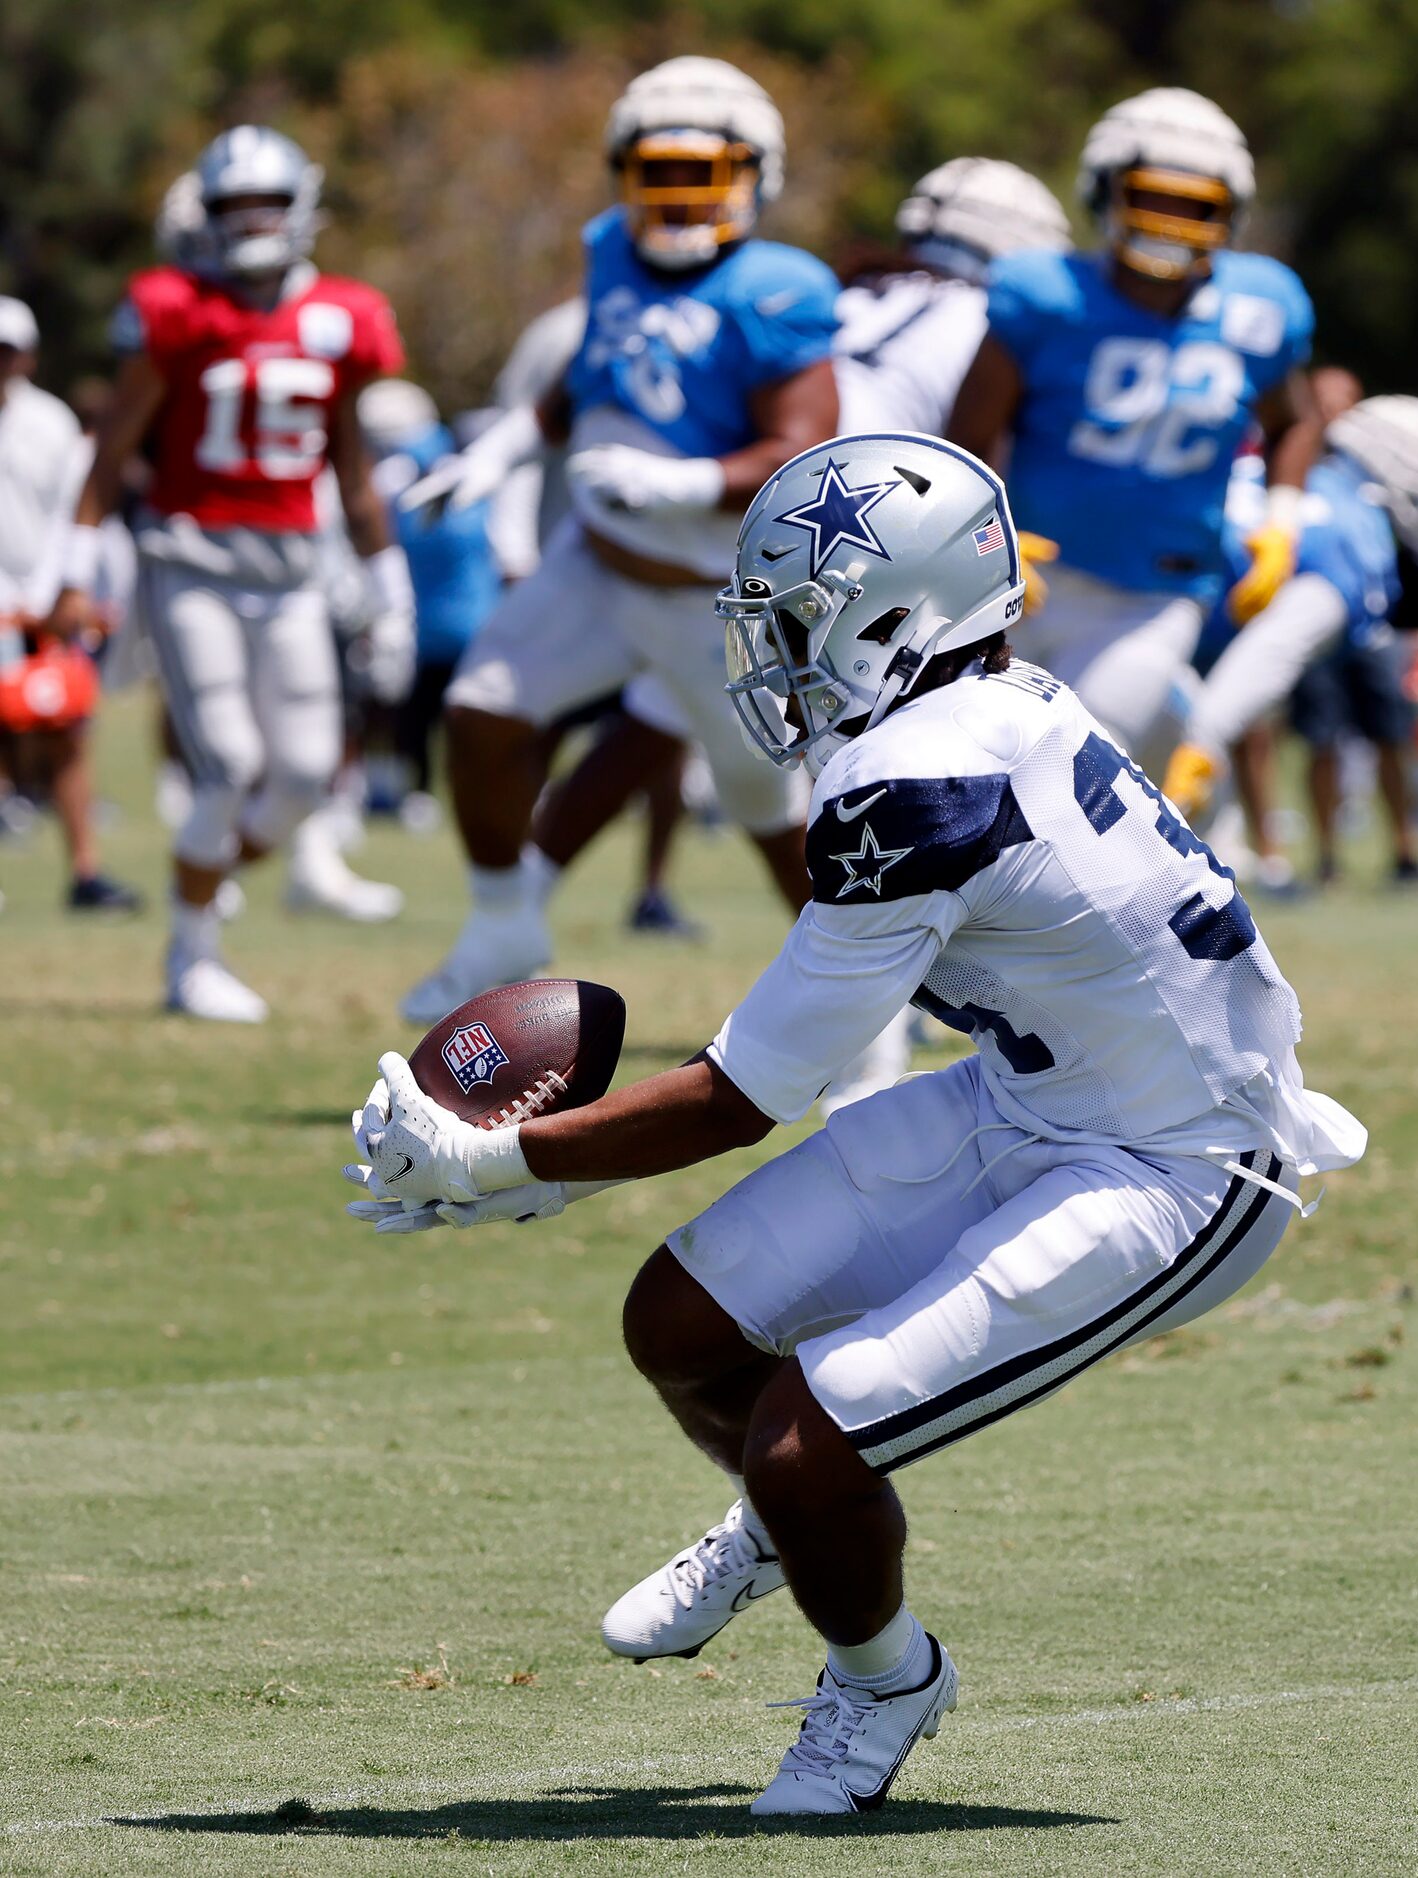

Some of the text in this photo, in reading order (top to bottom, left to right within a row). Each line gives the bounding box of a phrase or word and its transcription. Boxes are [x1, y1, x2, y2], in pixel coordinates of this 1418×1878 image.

[197, 357, 335, 480] 15
[1068, 335, 1246, 478] 92
[449, 1026, 490, 1066] NFL
